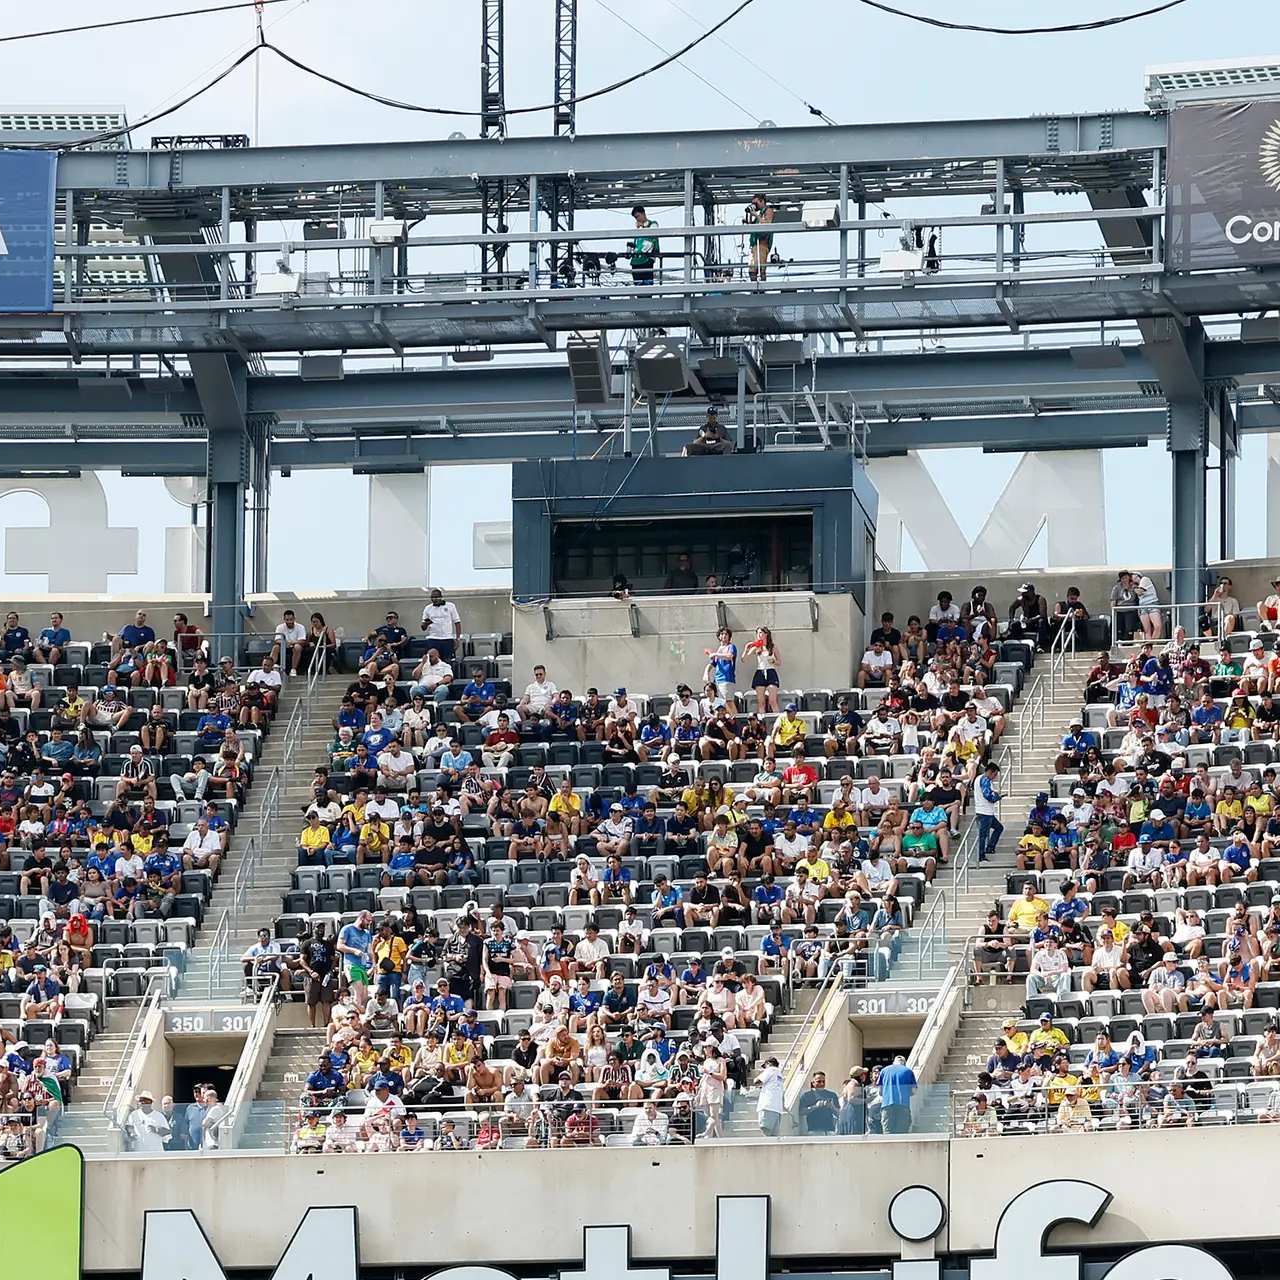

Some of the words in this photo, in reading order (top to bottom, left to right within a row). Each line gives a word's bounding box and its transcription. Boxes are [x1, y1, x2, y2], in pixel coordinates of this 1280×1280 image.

[857, 998, 886, 1014] 301
[172, 1017, 205, 1033] 350
[222, 1016, 253, 1033] 301
